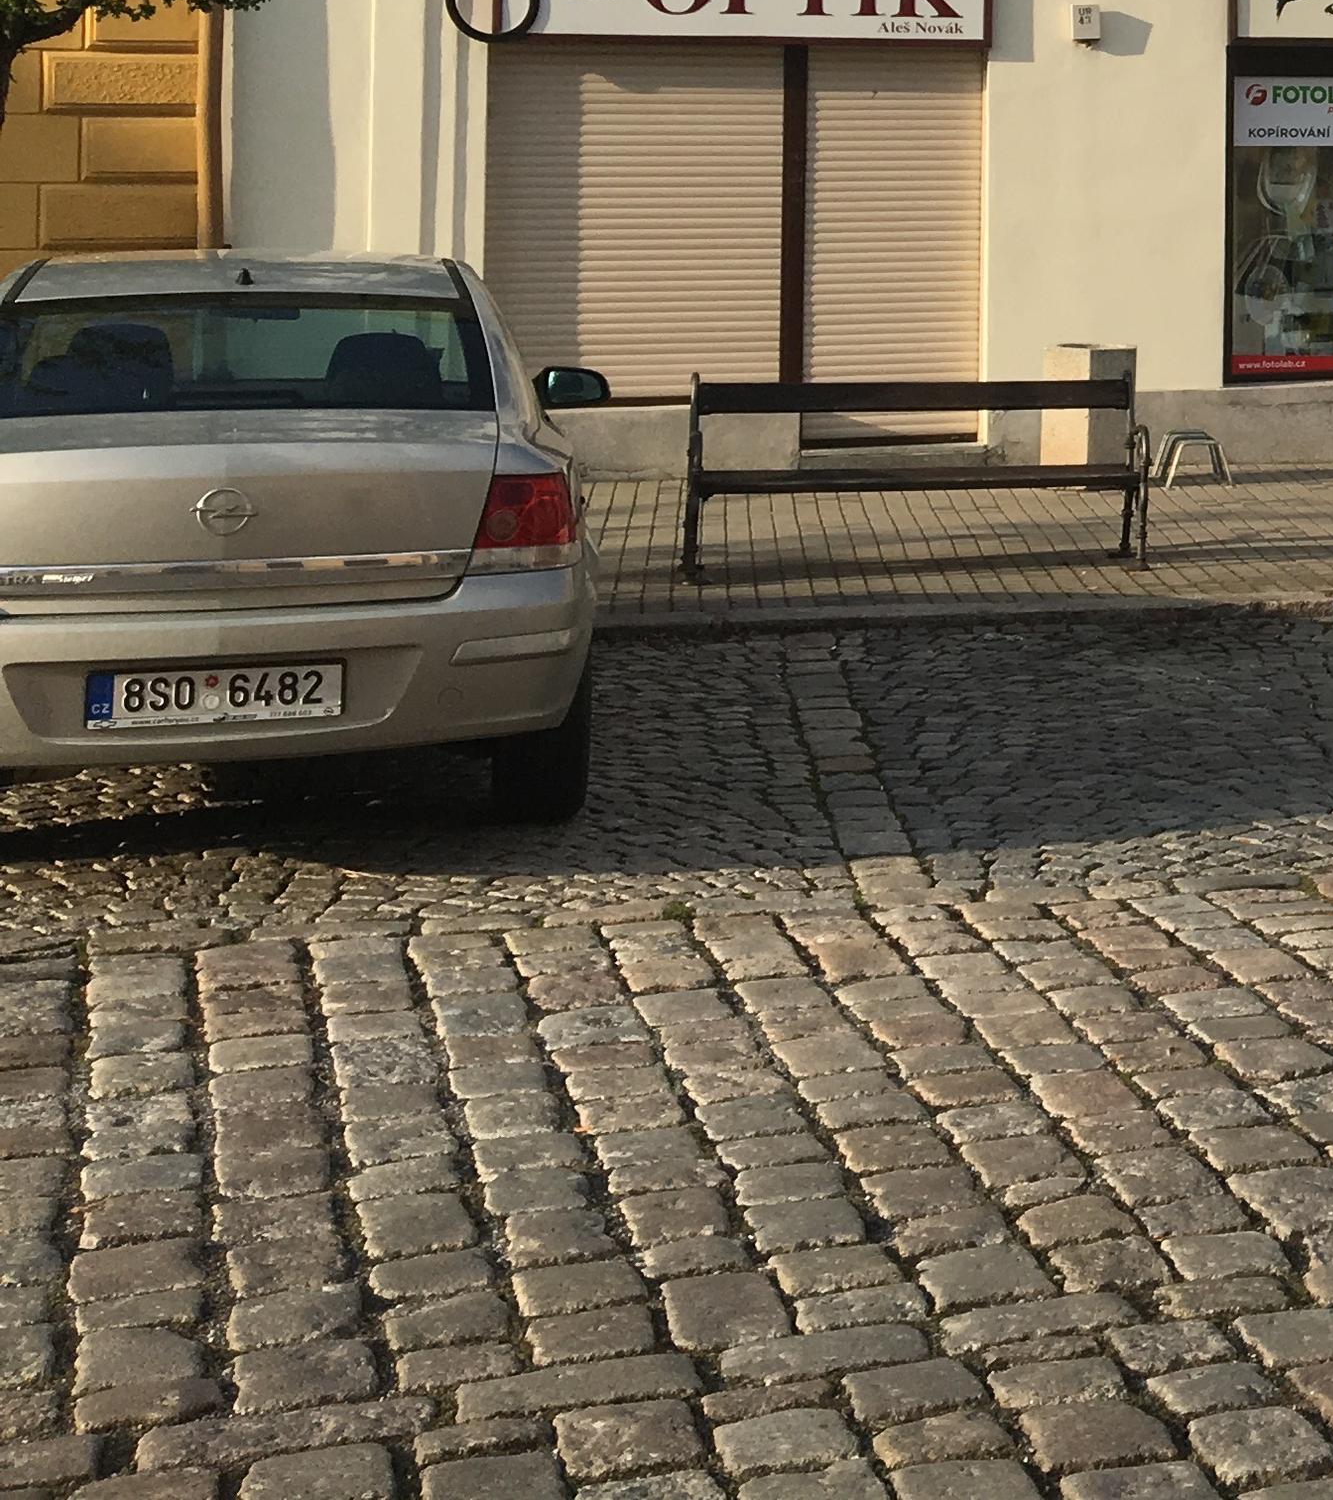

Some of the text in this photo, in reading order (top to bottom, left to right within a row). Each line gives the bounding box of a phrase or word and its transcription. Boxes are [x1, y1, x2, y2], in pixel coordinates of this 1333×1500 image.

[877, 21, 964, 34] Aleš Novák
[1249, 125, 1331, 138] KOPÍROVÁNÍ
[228, 670, 323, 708] 6482
[91, 703, 110, 714] CZ
